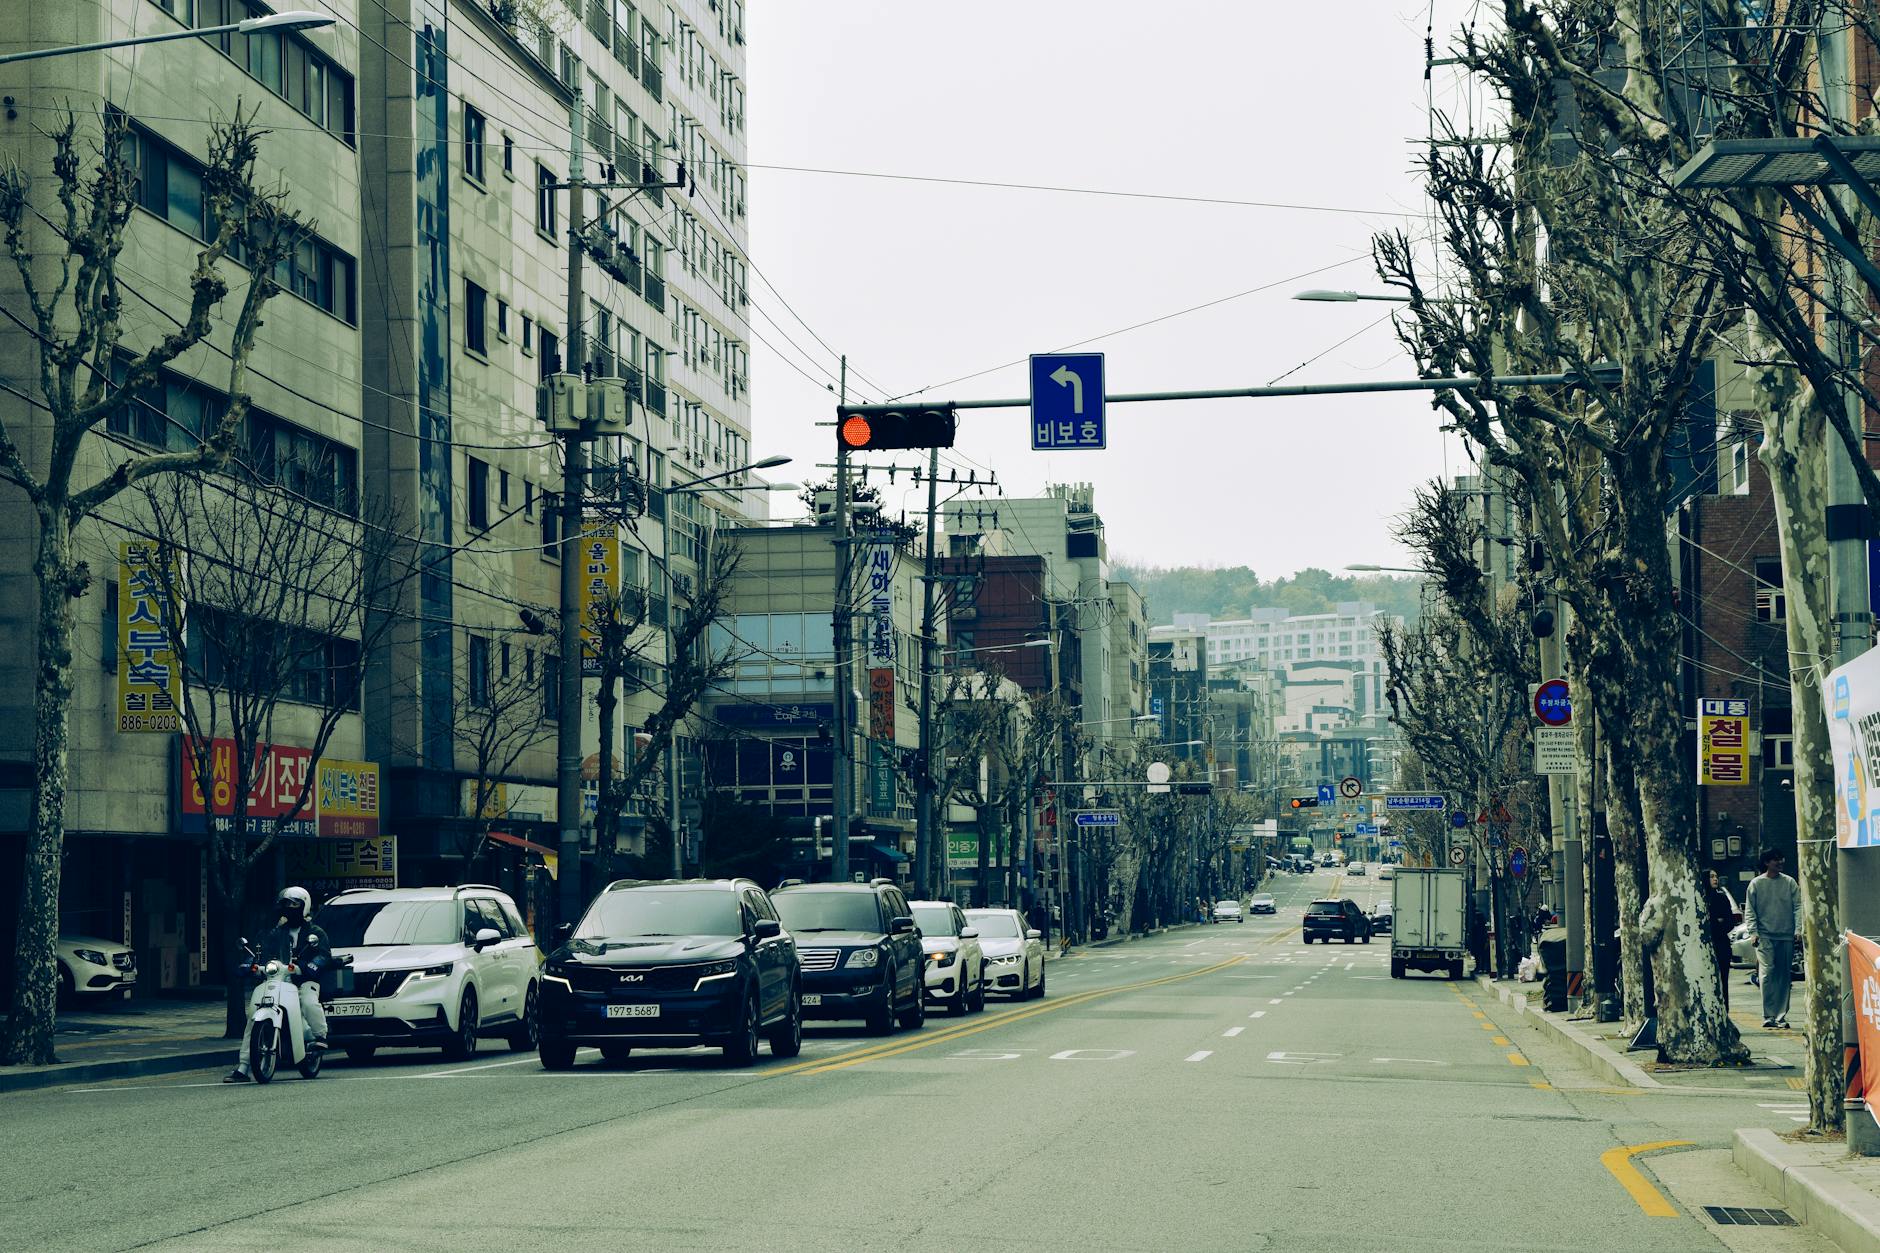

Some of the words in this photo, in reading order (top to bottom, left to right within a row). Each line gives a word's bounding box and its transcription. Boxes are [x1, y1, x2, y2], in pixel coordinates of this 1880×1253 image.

[1037, 420, 1100, 446] 비보호
[126, 693, 173, 711] 철물
[1705, 700, 1746, 715] 대풍
[121, 715, 177, 731] 886-0203
[1709, 719, 1744, 781] 철물
[381, 840, 393, 871] 철물
[350, 1005, 371, 1015] 7976
[634, 1006, 658, 1016] 5687
